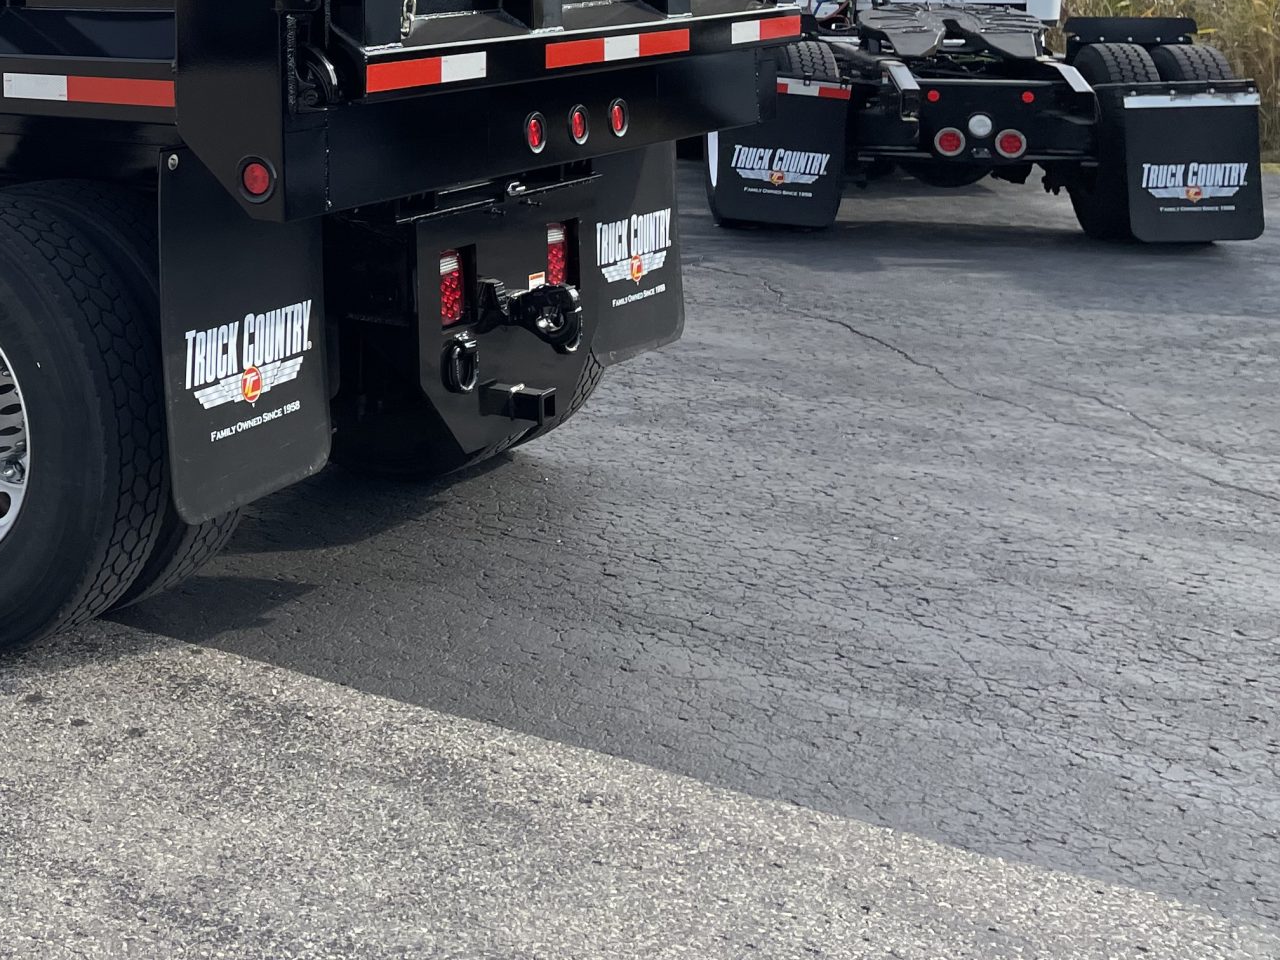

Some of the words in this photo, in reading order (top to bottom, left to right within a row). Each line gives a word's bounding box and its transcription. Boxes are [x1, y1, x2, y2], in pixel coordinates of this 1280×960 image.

[731, 144, 773, 169] TRUCK
[773, 148, 830, 175] COUNTRY
[1142, 163, 1185, 188] TRUCK
[1187, 162, 1248, 187] COUNTRY
[596, 219, 628, 266] TRUCK
[630, 208, 671, 256] COUNTRY
[185, 321, 239, 390] TRUCK
[242, 299, 312, 371] COUNTRY
[211, 425, 236, 442] FAMILY
[236, 416, 263, 432] OWNED
[263, 407, 282, 422] SINCE
[283, 400, 301, 415] 1958
